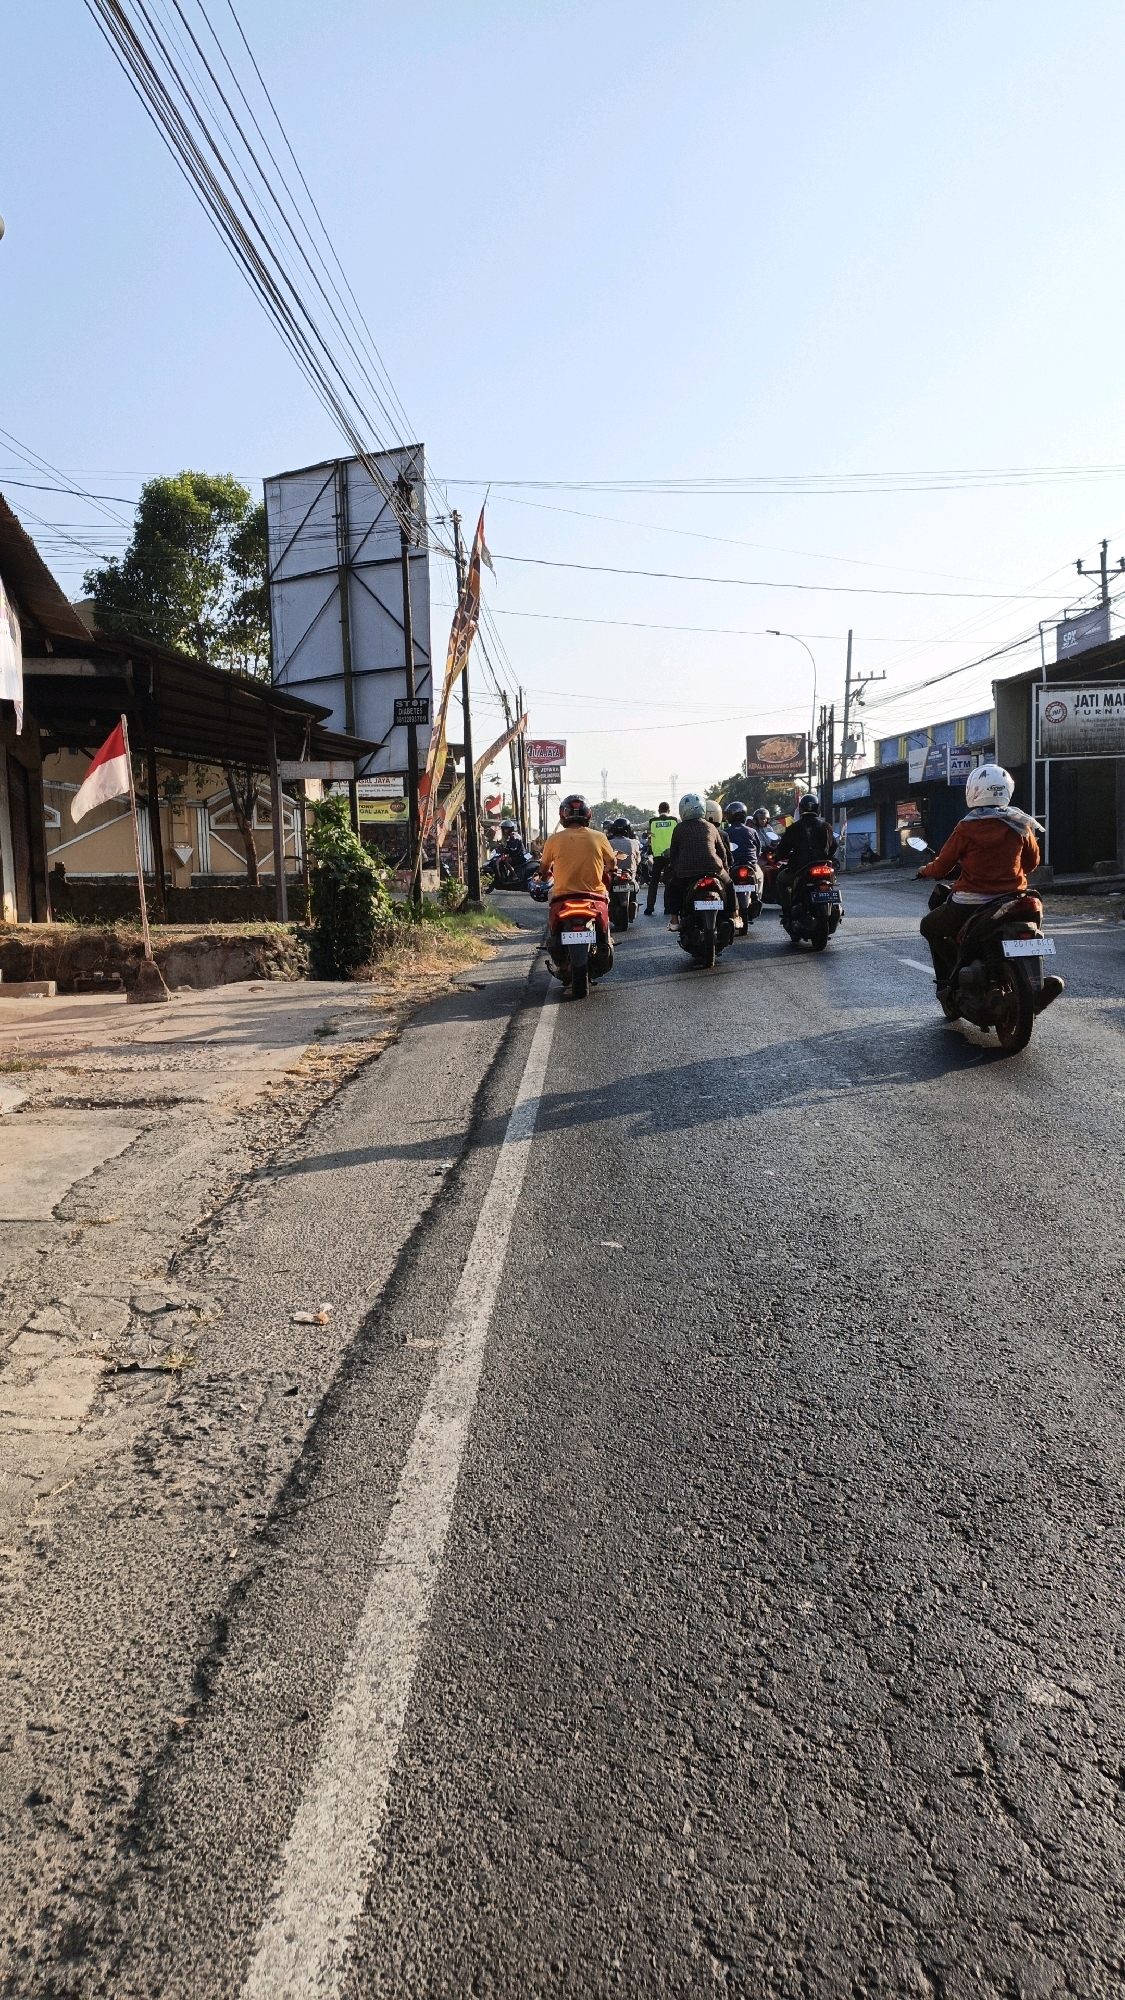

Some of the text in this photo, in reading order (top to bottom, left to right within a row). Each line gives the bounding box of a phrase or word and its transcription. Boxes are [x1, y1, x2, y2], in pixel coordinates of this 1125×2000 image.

[1074, 694, 1099, 708] JATI
[1103, 693, 1125, 707] MA
[398, 707, 423, 715] DIABETES
[1075, 708, 1125, 716] FURNI
[951, 760, 971, 769] ATM
